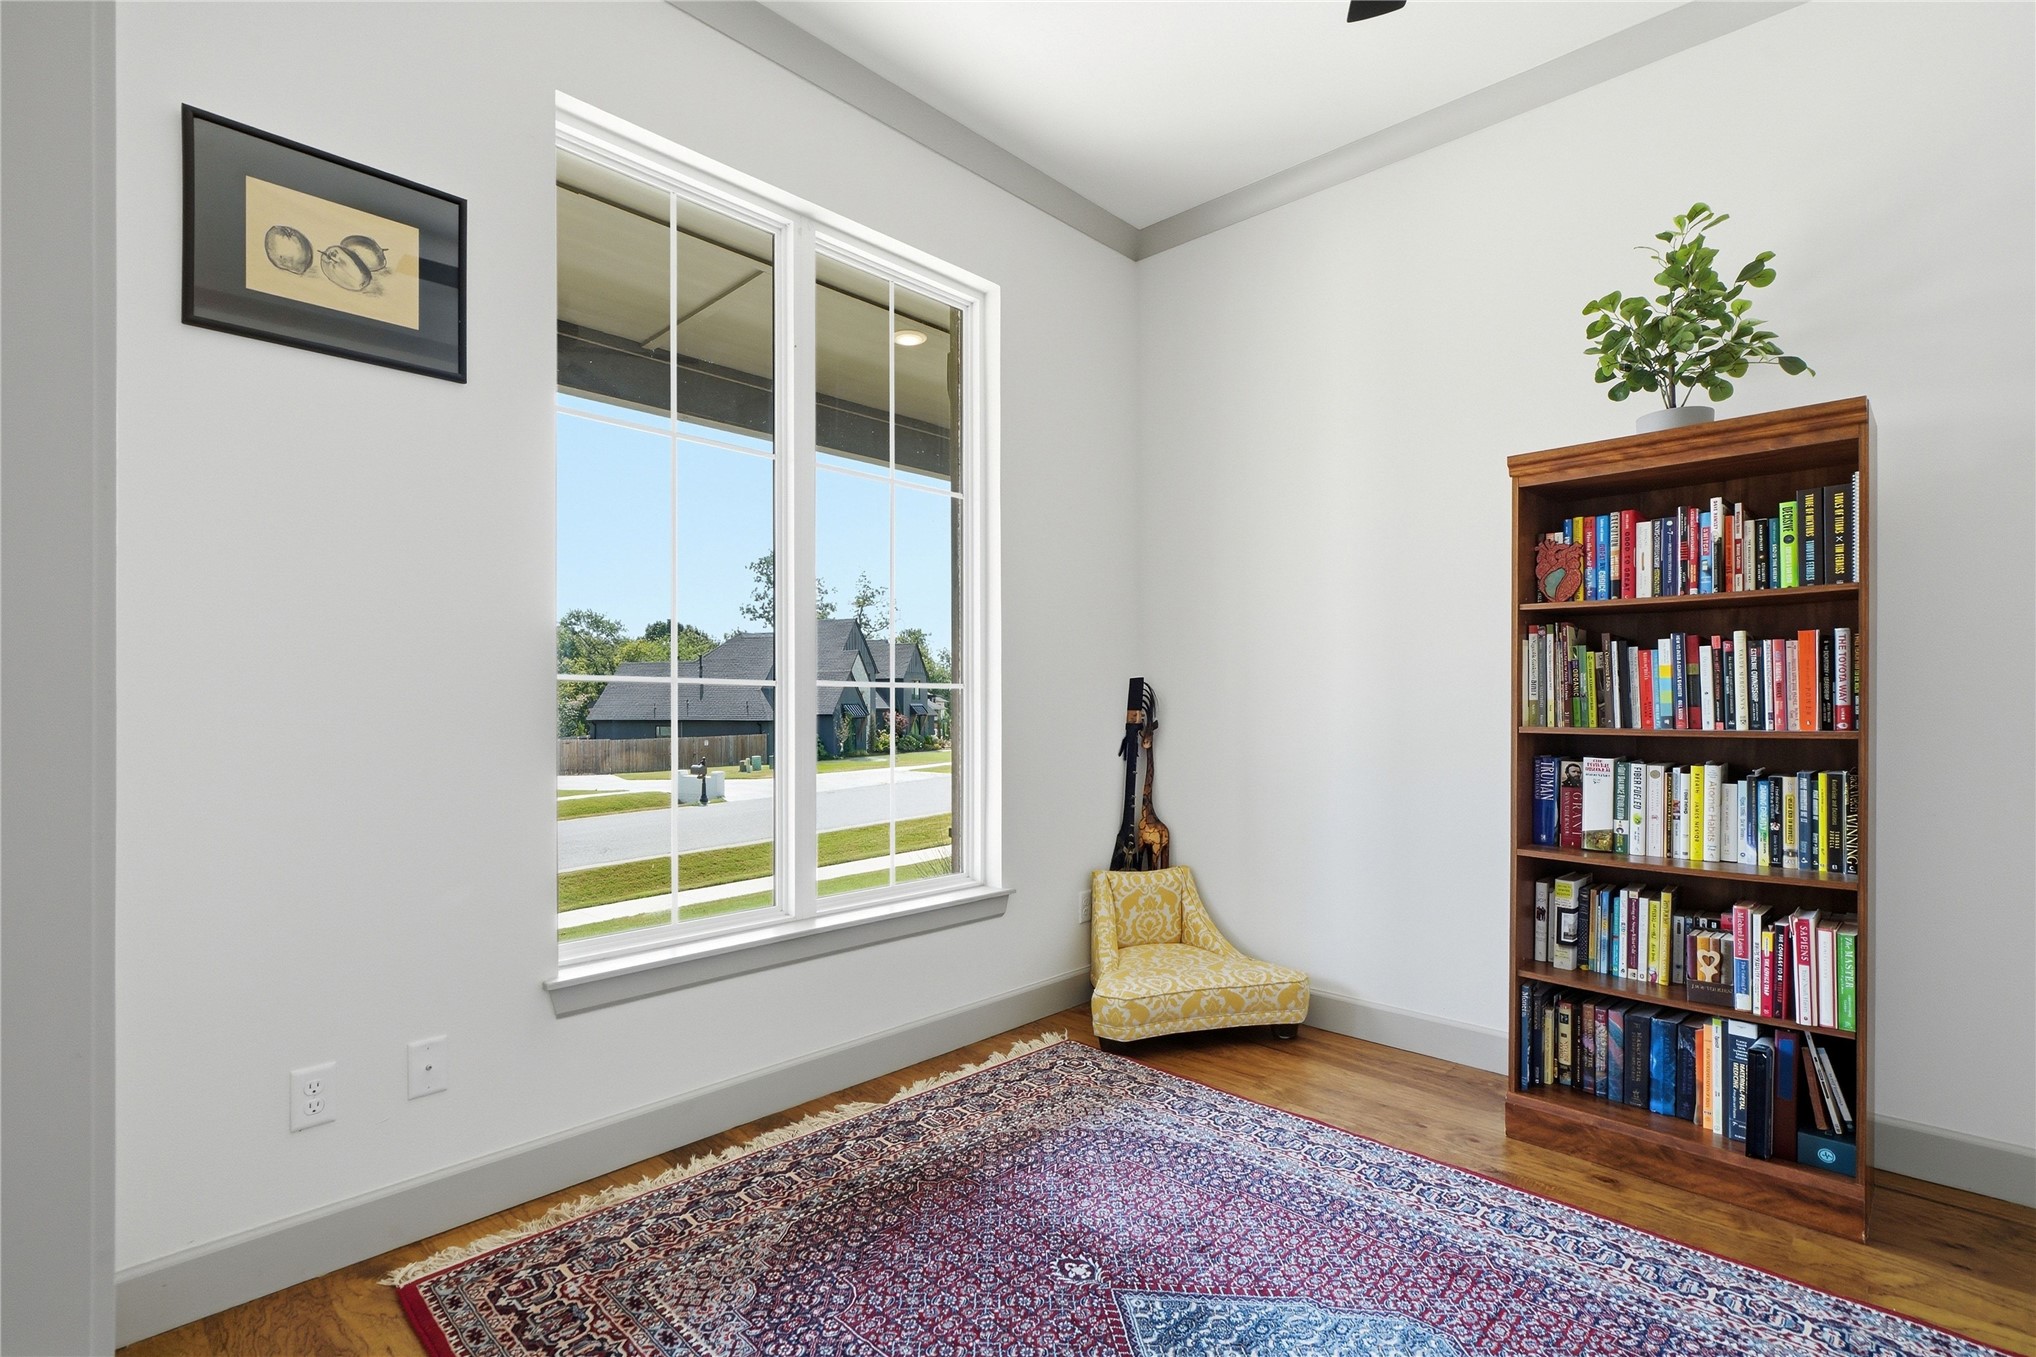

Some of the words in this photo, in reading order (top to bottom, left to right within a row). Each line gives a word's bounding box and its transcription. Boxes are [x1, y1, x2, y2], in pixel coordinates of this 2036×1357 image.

[1834, 492, 1843, 508] TOOLS
[1782, 506, 1794, 532] DECISIVE
[1625, 556, 1630, 564] TO
[1835, 543, 1844, 553] TIM
[1838, 634, 1846, 650] THE
[1839, 652, 1847, 682] TOYOTA
[1839, 684, 1847, 702] WAY
[1541, 761, 1554, 800] TRUMAN
[1634, 767, 1642, 784] FIBER
[1633, 786, 1642, 809] FUELED
[1708, 781, 1716, 812] Atomic
[1572, 792, 1582, 837] GRANT
[1707, 815, 1716, 842] Habits
[1846, 814, 1858, 864] WINNING
[1799, 925, 1809, 962] SAPIENS
[1845, 951, 1854, 988] MASTER
